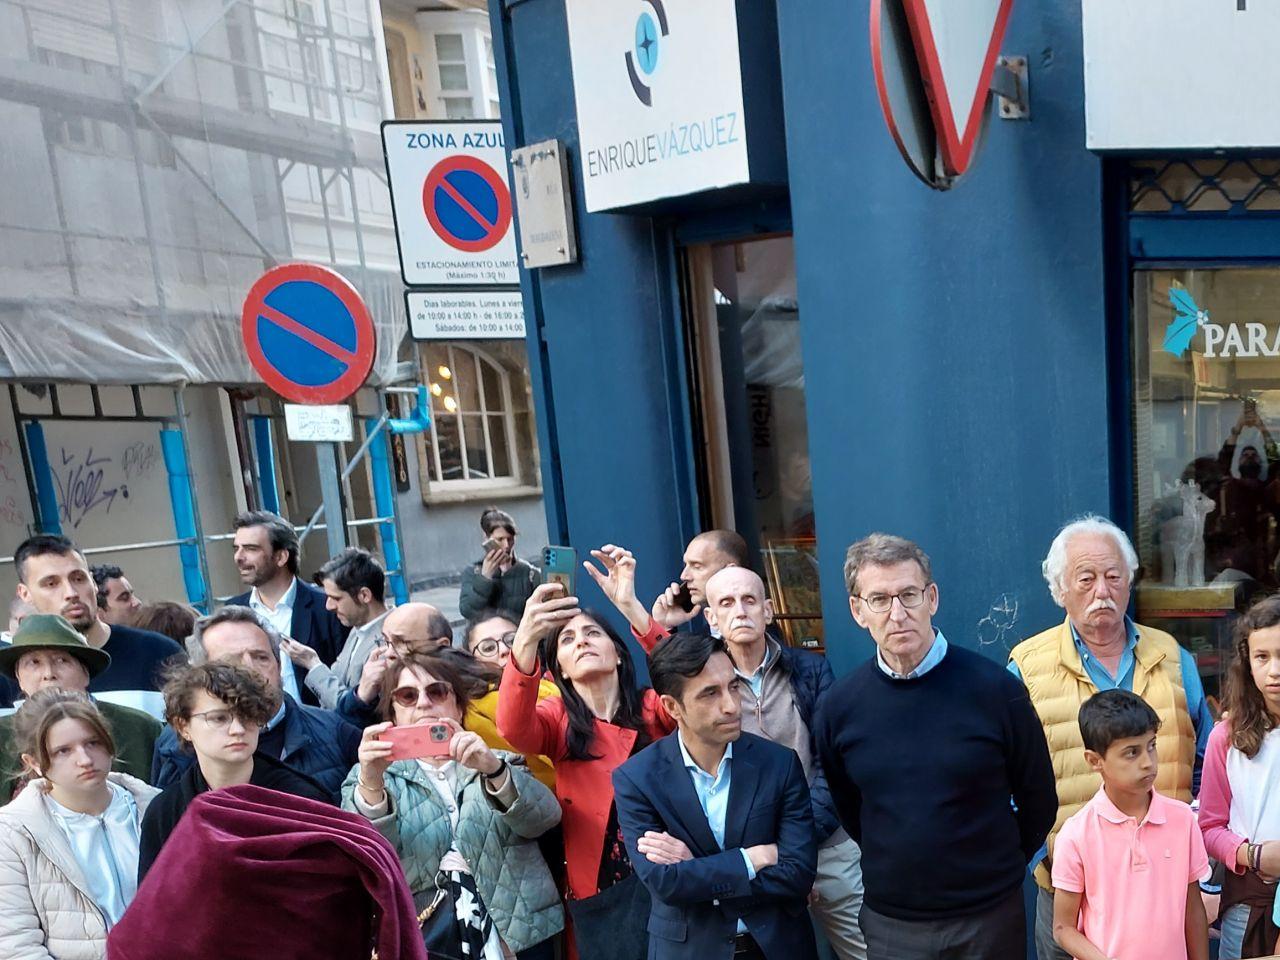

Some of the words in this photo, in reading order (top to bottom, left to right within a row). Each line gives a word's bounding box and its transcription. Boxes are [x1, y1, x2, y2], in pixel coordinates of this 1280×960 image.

[406, 133, 457, 149] ZONA
[416, 261, 493, 269] ESTACIONAMIENTO
[498, 271, 506, 279] h)
[417, 312, 425, 320] de
[427, 312, 446, 320] 10:00
[454, 312, 471, 320] 14:00
[468, 323, 477, 332] de
[479, 324, 497, 332] 10:00
